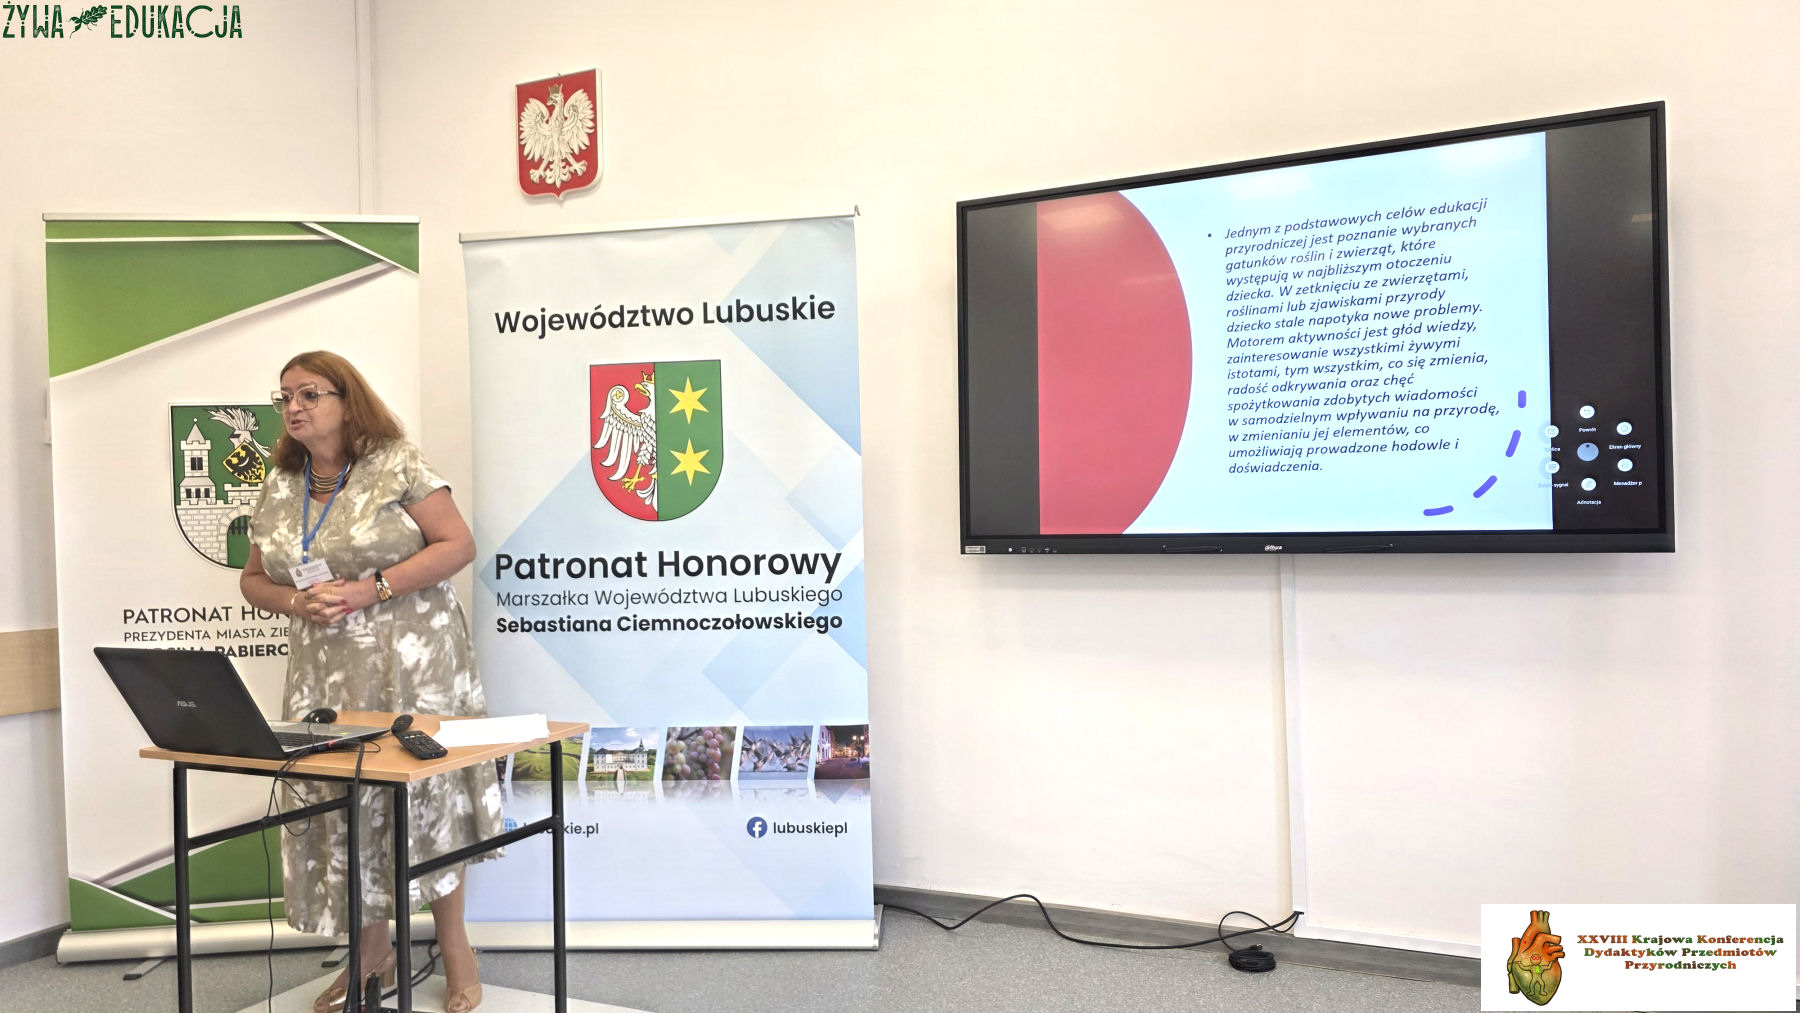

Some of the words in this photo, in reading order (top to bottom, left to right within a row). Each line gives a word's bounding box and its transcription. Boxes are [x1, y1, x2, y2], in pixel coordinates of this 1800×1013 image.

[1224, 225, 1271, 239] Jednym
[1275, 225, 1280, 233] z
[1284, 210, 1382, 234] podstawowych
[1386, 206, 1426, 220] celów
[1429, 198, 1488, 215] edukacji
[1225, 236, 1308, 257] przyrodniczej
[1310, 234, 1333, 248] jest
[1337, 226, 1397, 244] poznanie
[1402, 216, 1477, 236] wybranych
[1226, 254, 1286, 272] gatunków
[1290, 249, 1325, 264] roślin
[1328, 248, 1332, 260] i
[1336, 243, 1396, 259] zwierząt,
[1401, 238, 1436, 252] które
[1226, 270, 1289, 286] występują
[1293, 270, 1304, 280] w
[1307, 260, 1382, 279] najbliższym
[1386, 254, 1452, 270] otoczeniu
[1226, 288, 1274, 302] dziecka.
[1279, 286, 1294, 296] W
[1296, 279, 1360, 296] zetknięciu
[1364, 279, 1378, 288] ze
[1382, 270, 1469, 286] zwierzętami,
[1226, 302, 1283, 317] roślinami
[1287, 301, 1306, 312] lub
[1310, 294, 1382, 312] zjawiskami
[1385, 288, 1446, 304] przyrody
[494, 304, 694, 339] Województwo
[703, 294, 836, 324] Lubuskie
[1226, 320, 1272, 332] dziecko
[1275, 316, 1304, 328] stale
[1308, 311, 1369, 328] napotyka
[1374, 309, 1409, 320] nowe
[1414, 302, 1482, 320] problemy.
[1226, 336, 1284, 348] Motorem
[1288, 328, 1360, 346] aktywności
[1363, 327, 1388, 340] jest
[1392, 322, 1422, 338] głód
[1426, 320, 1476, 332] wiedzy,
[1227, 350, 1328, 364] zainteresowanie
[1333, 341, 1404, 358] wszystkimi
[1408, 336, 1460, 352] żywymi
[1227, 366, 1280, 380] istotami,
[1285, 364, 1309, 378] tym
[1313, 360, 1384, 375] wszystkim,
[1388, 359, 1403, 368] co
[1407, 356, 1426, 369] się
[1430, 353, 1488, 367] zmienia,
[1228, 382, 1268, 395] radość
[1272, 378, 1346, 394] odkrywania
[1350, 377, 1379, 388] oraz
[1383, 373, 1414, 387] chęć
[1228, 396, 1320, 412] spożytkowania
[1324, 392, 1390, 408] zdobytych
[1395, 387, 1478, 402] wiadomości
[1228, 417, 1238, 426] w
[1242, 411, 1332, 426] samodzielnym
[1336, 406, 1408, 422] wpływaniu
[1412, 408, 1430, 418] na
[1434, 402, 1500, 418] przyrodę,
[1228, 432, 1239, 442] w
[1242, 428, 1310, 442] zmienianiu
[1314, 428, 1329, 441] jej
[1333, 424, 1410, 438] elementów,
[1414, 424, 1430, 434] co
[1228, 444, 1303, 459] umożliwiają
[1307, 442, 1388, 457] prowadzone
[1392, 439, 1450, 451] hodowle
[1454, 438, 1459, 449] i
[1229, 460, 1323, 474] doświadczenia.
[495, 551, 648, 580] Patronat
[658, 550, 842, 584] Honorowy
[496, 590, 589, 606] Marszałka
[594, 588, 728, 609] Województwa
[734, 586, 843, 606] Lubuskiego
[123, 607, 232, 624] PATRONAT
[496, 614, 612, 633] Sebastiana
[617, 612, 843, 634] Ciemnoczołowskiego
[124, 630, 211, 642] PREZYDENTA
[217, 628, 266, 639] MIASTA
[773, 821, 848, 838] lubuskiepl
